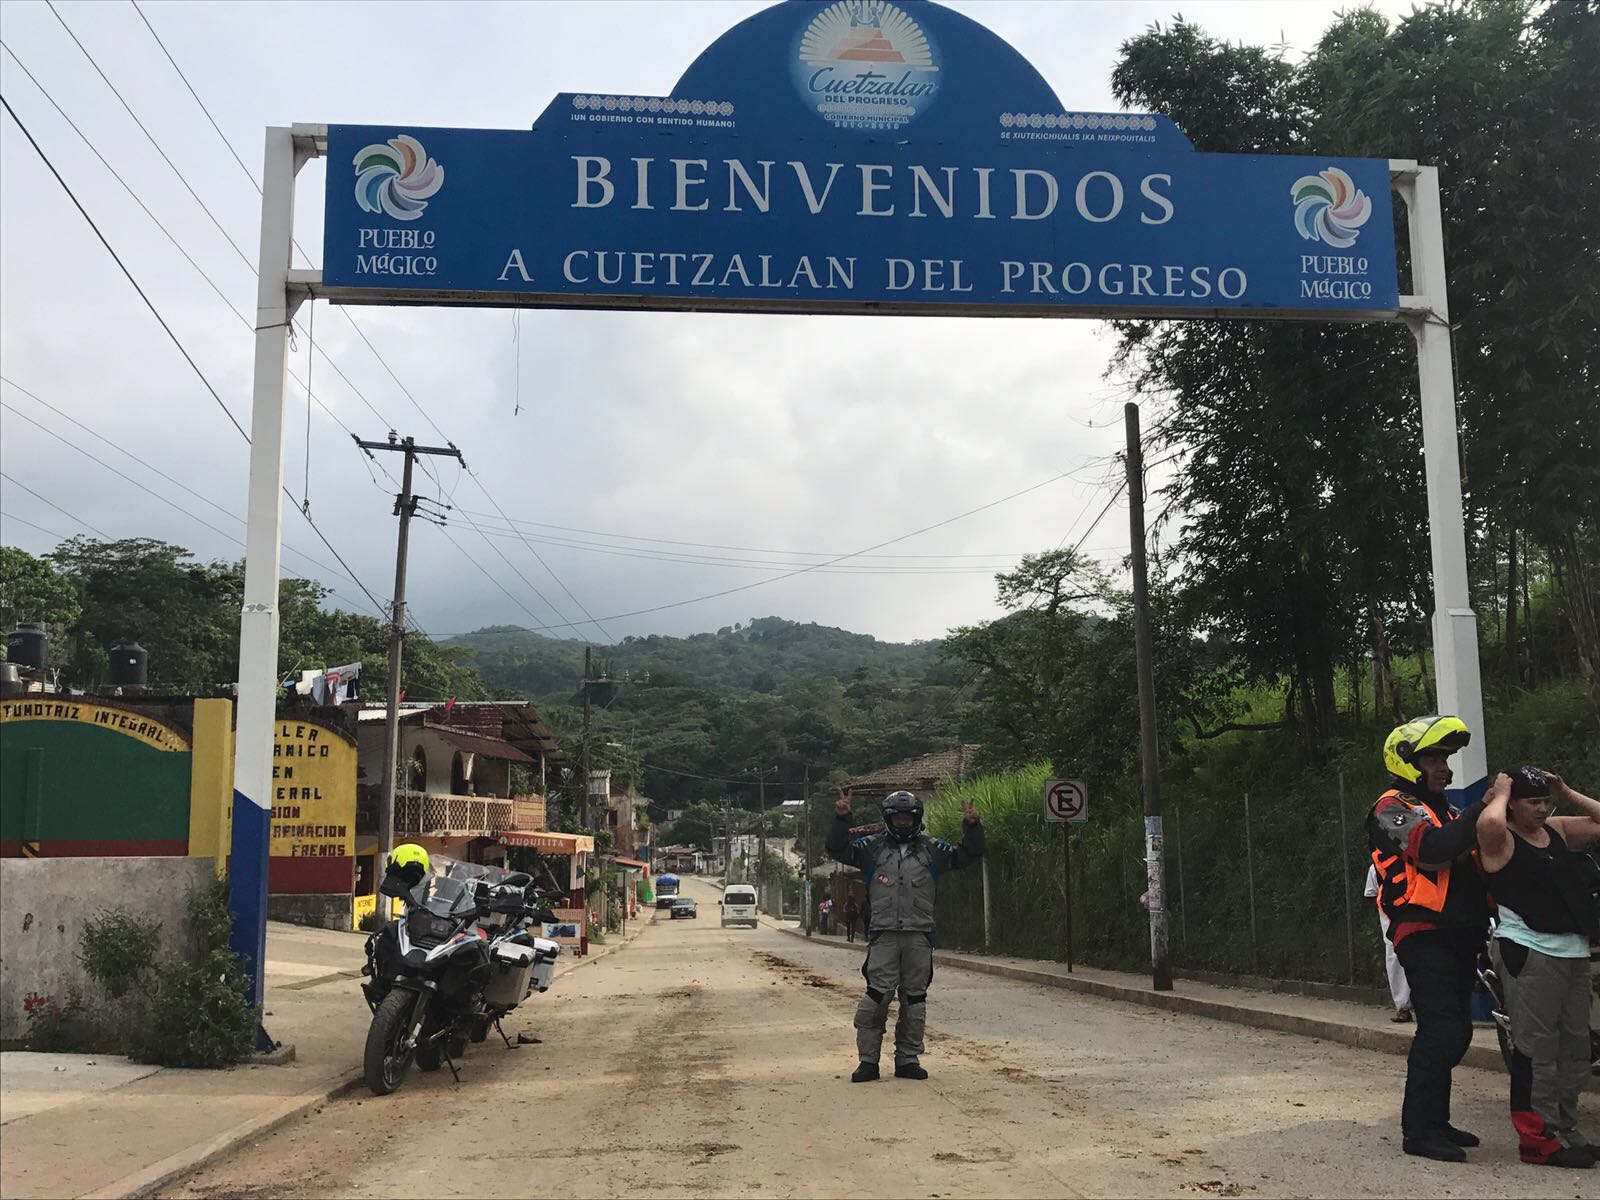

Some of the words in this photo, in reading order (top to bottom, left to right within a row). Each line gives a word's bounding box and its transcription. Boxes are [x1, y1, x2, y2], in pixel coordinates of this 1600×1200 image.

[808, 66, 937, 97] Cuetzalan
[824, 94, 846, 104] DEL
[848, 95, 909, 106] PROGRESO
[589, 114, 634, 123] GOBIERNO
[636, 116, 654, 124] CON
[657, 117, 694, 126] SENTIDO
[696, 119, 736, 128] HUMANO!
[824, 113, 866, 122] GOBIERNO
[867, 115, 910, 124] MUNICIPAL
[1000, 131, 1011, 140] SE
[1082, 133, 1096, 141] IKA
[570, 154, 1175, 225] BIENVENIDOS
[496, 248, 535, 282] A
[562, 249, 858, 290] CUETZALAN
[885, 257, 974, 293] DEL
[999, 260, 1249, 300] PROGRESO
[1057, 789, 1074, 812] E
[509, 837, 565, 848] JUQUILITA
[291, 844, 346, 857] FRENOS
